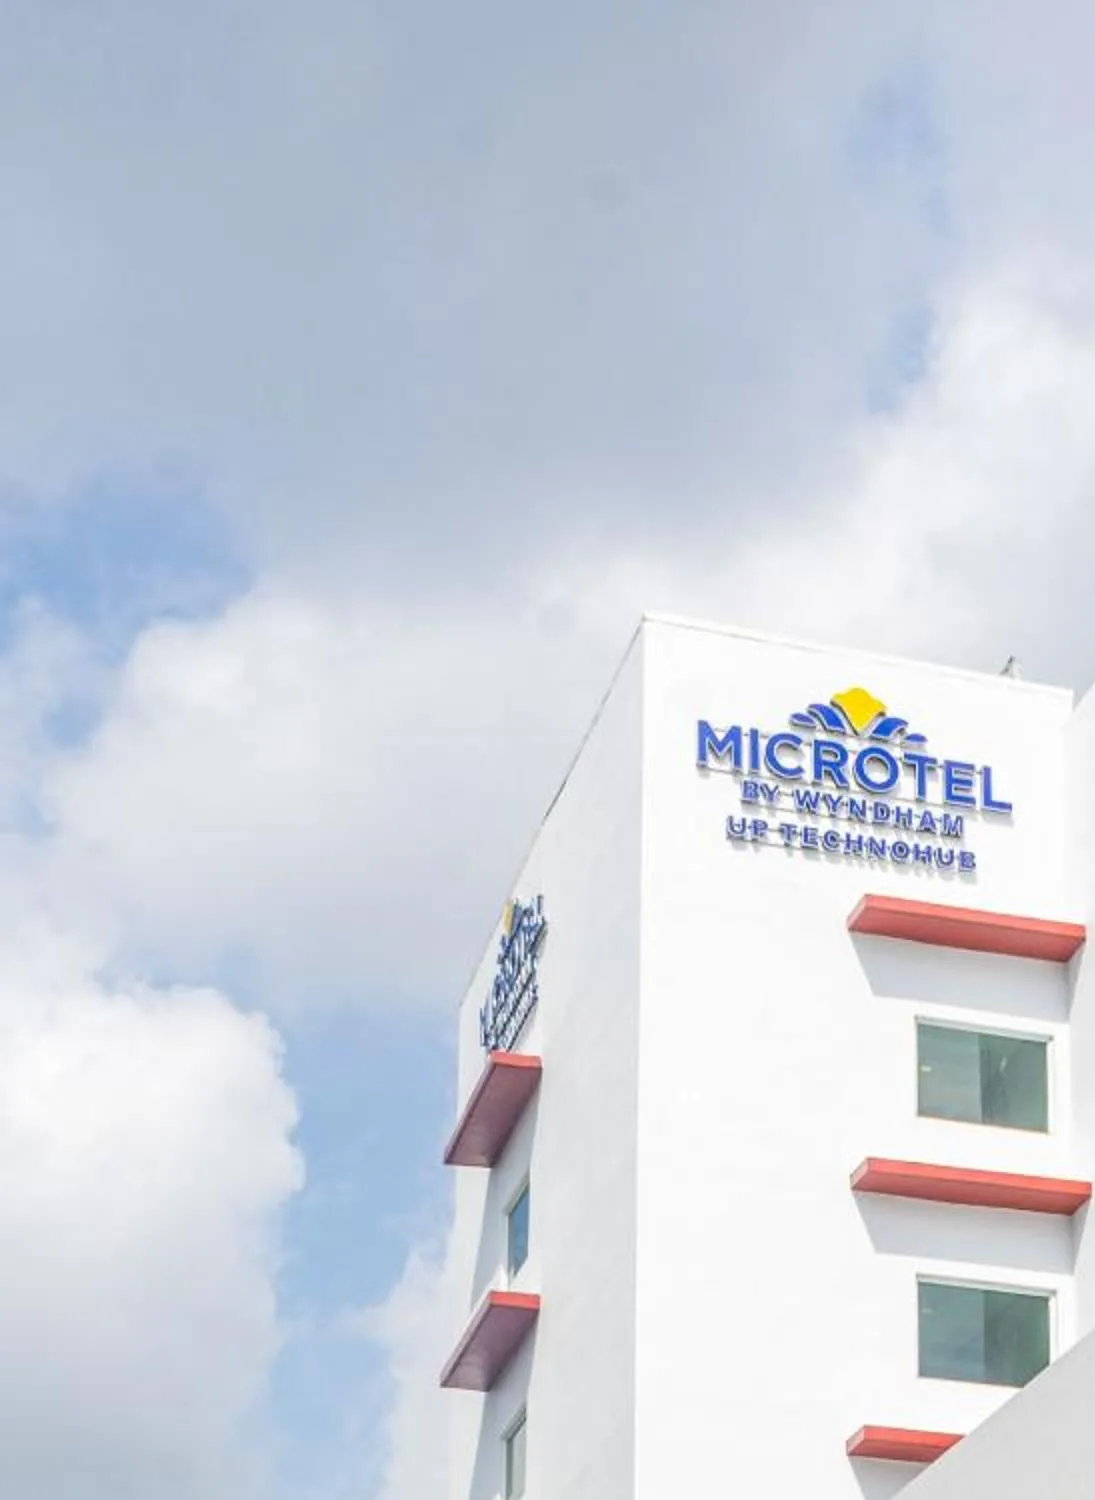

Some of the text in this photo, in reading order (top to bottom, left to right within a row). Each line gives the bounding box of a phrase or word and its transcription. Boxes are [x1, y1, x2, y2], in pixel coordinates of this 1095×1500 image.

[696, 719, 1013, 813] MICROTEL
[740, 779, 965, 839] BY WYNDHAM
[726, 815, 977, 873] UP TECHNOHUB
